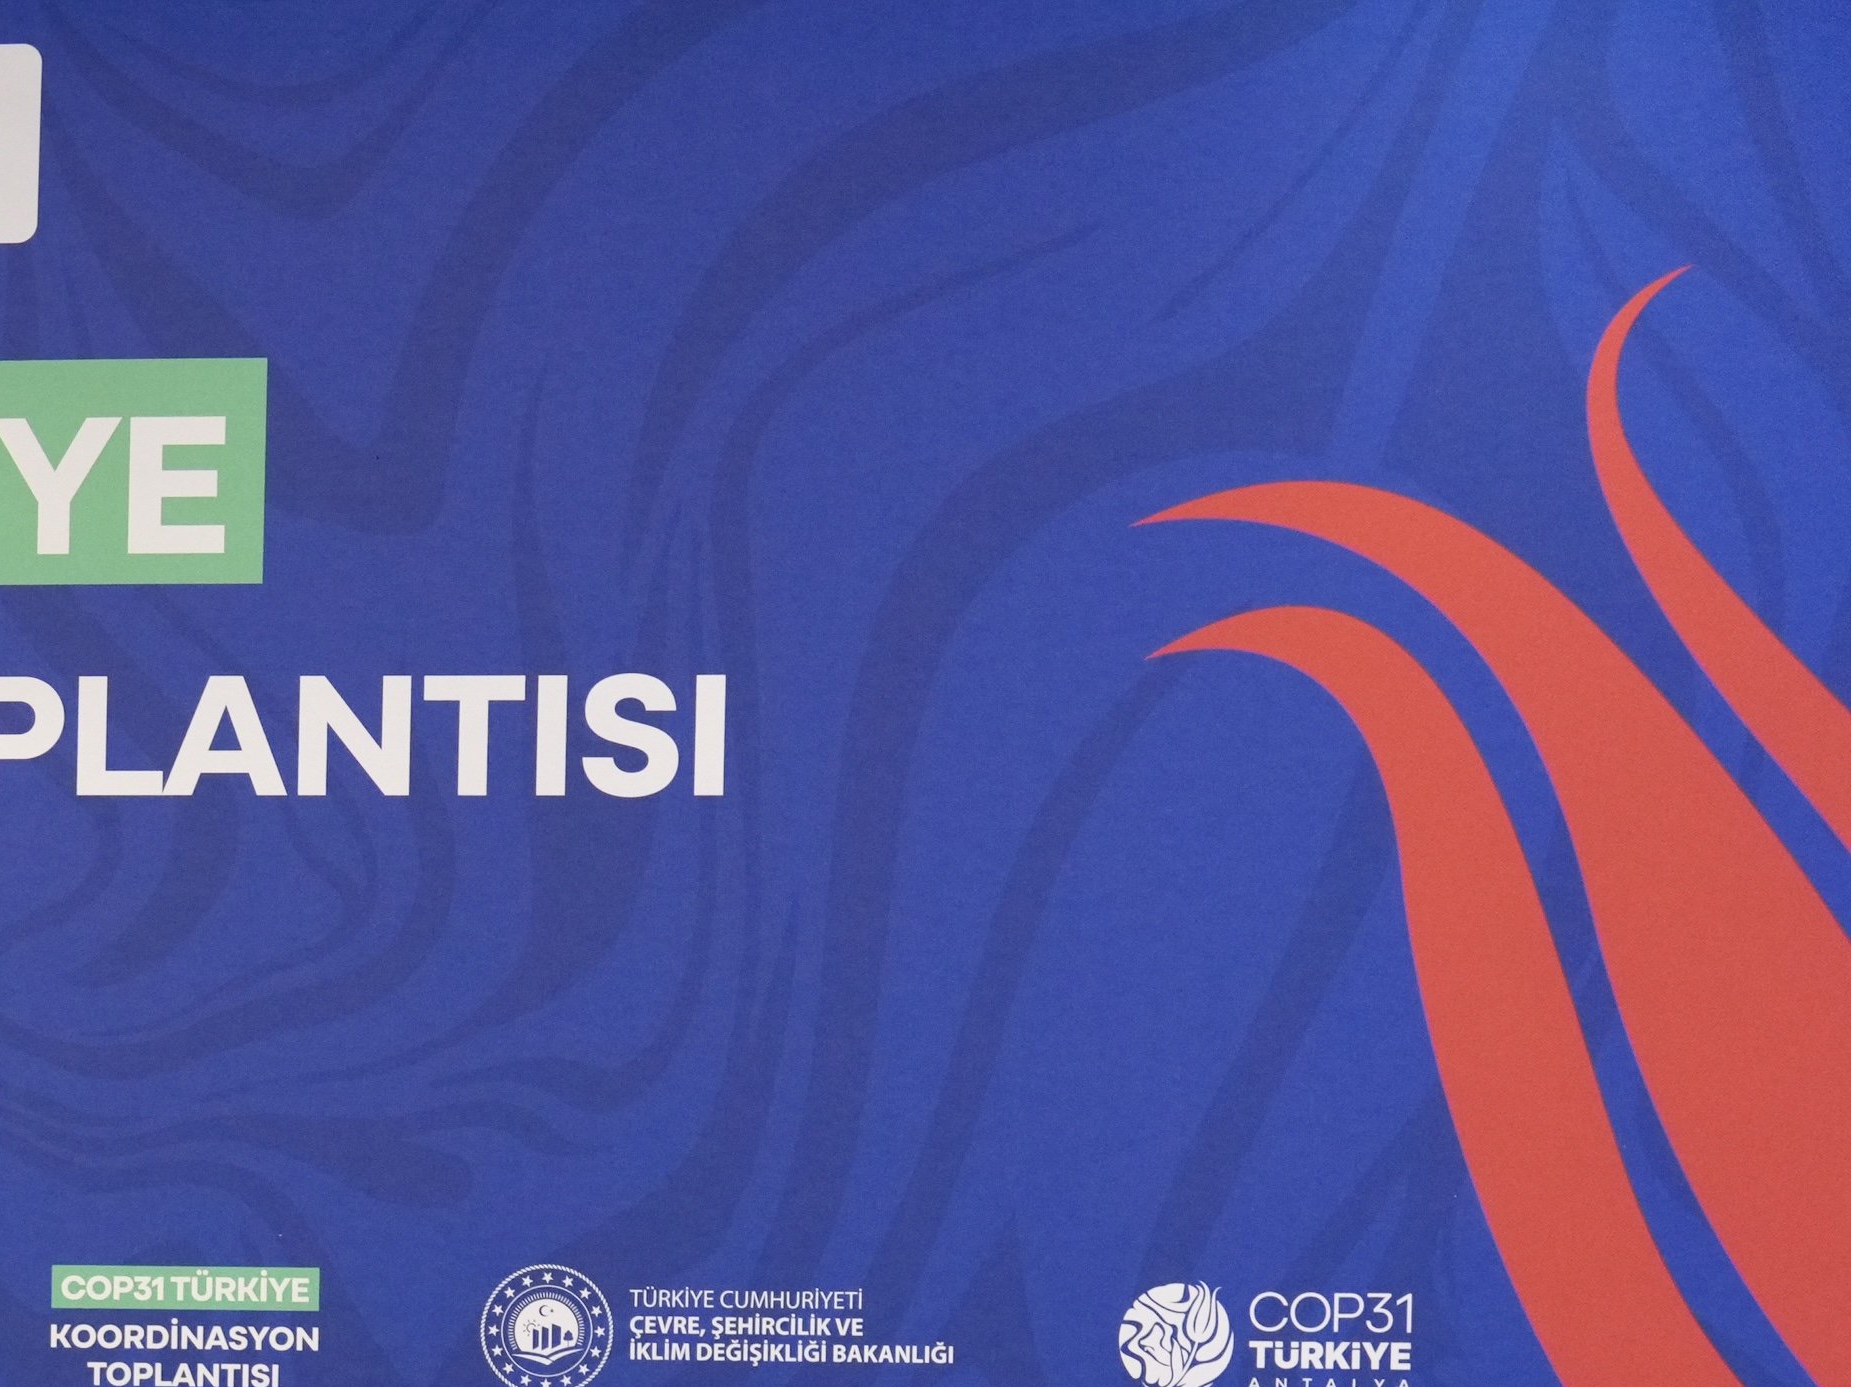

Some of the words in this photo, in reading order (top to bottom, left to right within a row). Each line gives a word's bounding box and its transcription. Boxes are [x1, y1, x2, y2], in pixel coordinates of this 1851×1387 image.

[62, 1275, 164, 1300] COP31
[171, 1269, 309, 1302] TÜRKİYE
[630, 1287, 714, 1308] TÜRKİYE
[720, 1288, 862, 1309] CUMHURİYETİ
[630, 1316, 705, 1338] ÇEVRE,
[712, 1313, 830, 1339] ŞEHİRCİLİK
[835, 1318, 863, 1336] VE
[1250, 1292, 1412, 1333] COP31
[51, 1318, 319, 1351] KOORDİNASYON
[630, 1340, 690, 1360] İKLİM
[697, 1341, 826, 1366] DEĞİŞİKLİĞİ
[833, 1342, 953, 1363] BAKANLIĞI
[1249, 1341, 1411, 1370] TÜRKİYE
[87, 1362, 279, 1387] TOPLANTISI
